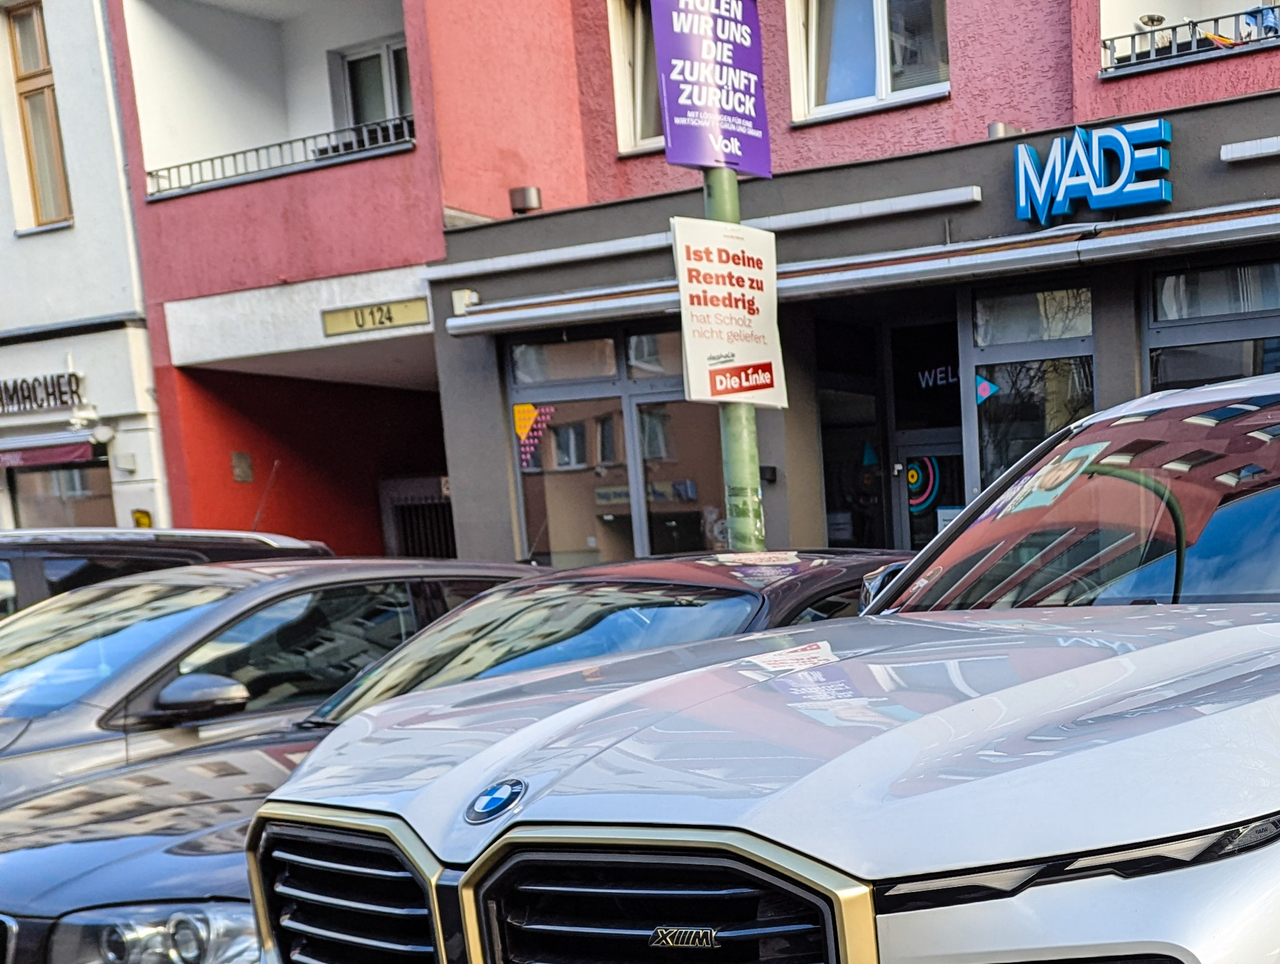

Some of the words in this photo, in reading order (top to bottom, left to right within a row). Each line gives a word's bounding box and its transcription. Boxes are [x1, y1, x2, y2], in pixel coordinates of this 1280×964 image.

[672, 11, 714, 37] WIR
[716, 18, 752, 47] UNS
[701, 39, 733, 65] DIE
[670, 59, 758, 95] ZUKUNFT
[678, 83, 756, 117] ZURÜCK
[708, 133, 742, 157] Volt
[1014, 118, 1172, 226] MADE
[685, 244, 714, 263] Ist
[717, 248, 764, 270] Deine
[687, 267, 745, 288] Rente
[748, 277, 764, 292] zu
[689, 290, 760, 316] niedrig,
[354, 308, 365, 328] U
[369, 305, 393, 326] 124
[690, 311, 711, 325] hat
[714, 312, 752, 329] Scholz
[692, 325, 724, 341] nicht
[715, 373, 740, 391] Die
[741, 366, 771, 387] Linke
[918, 365, 959, 389] WEL
